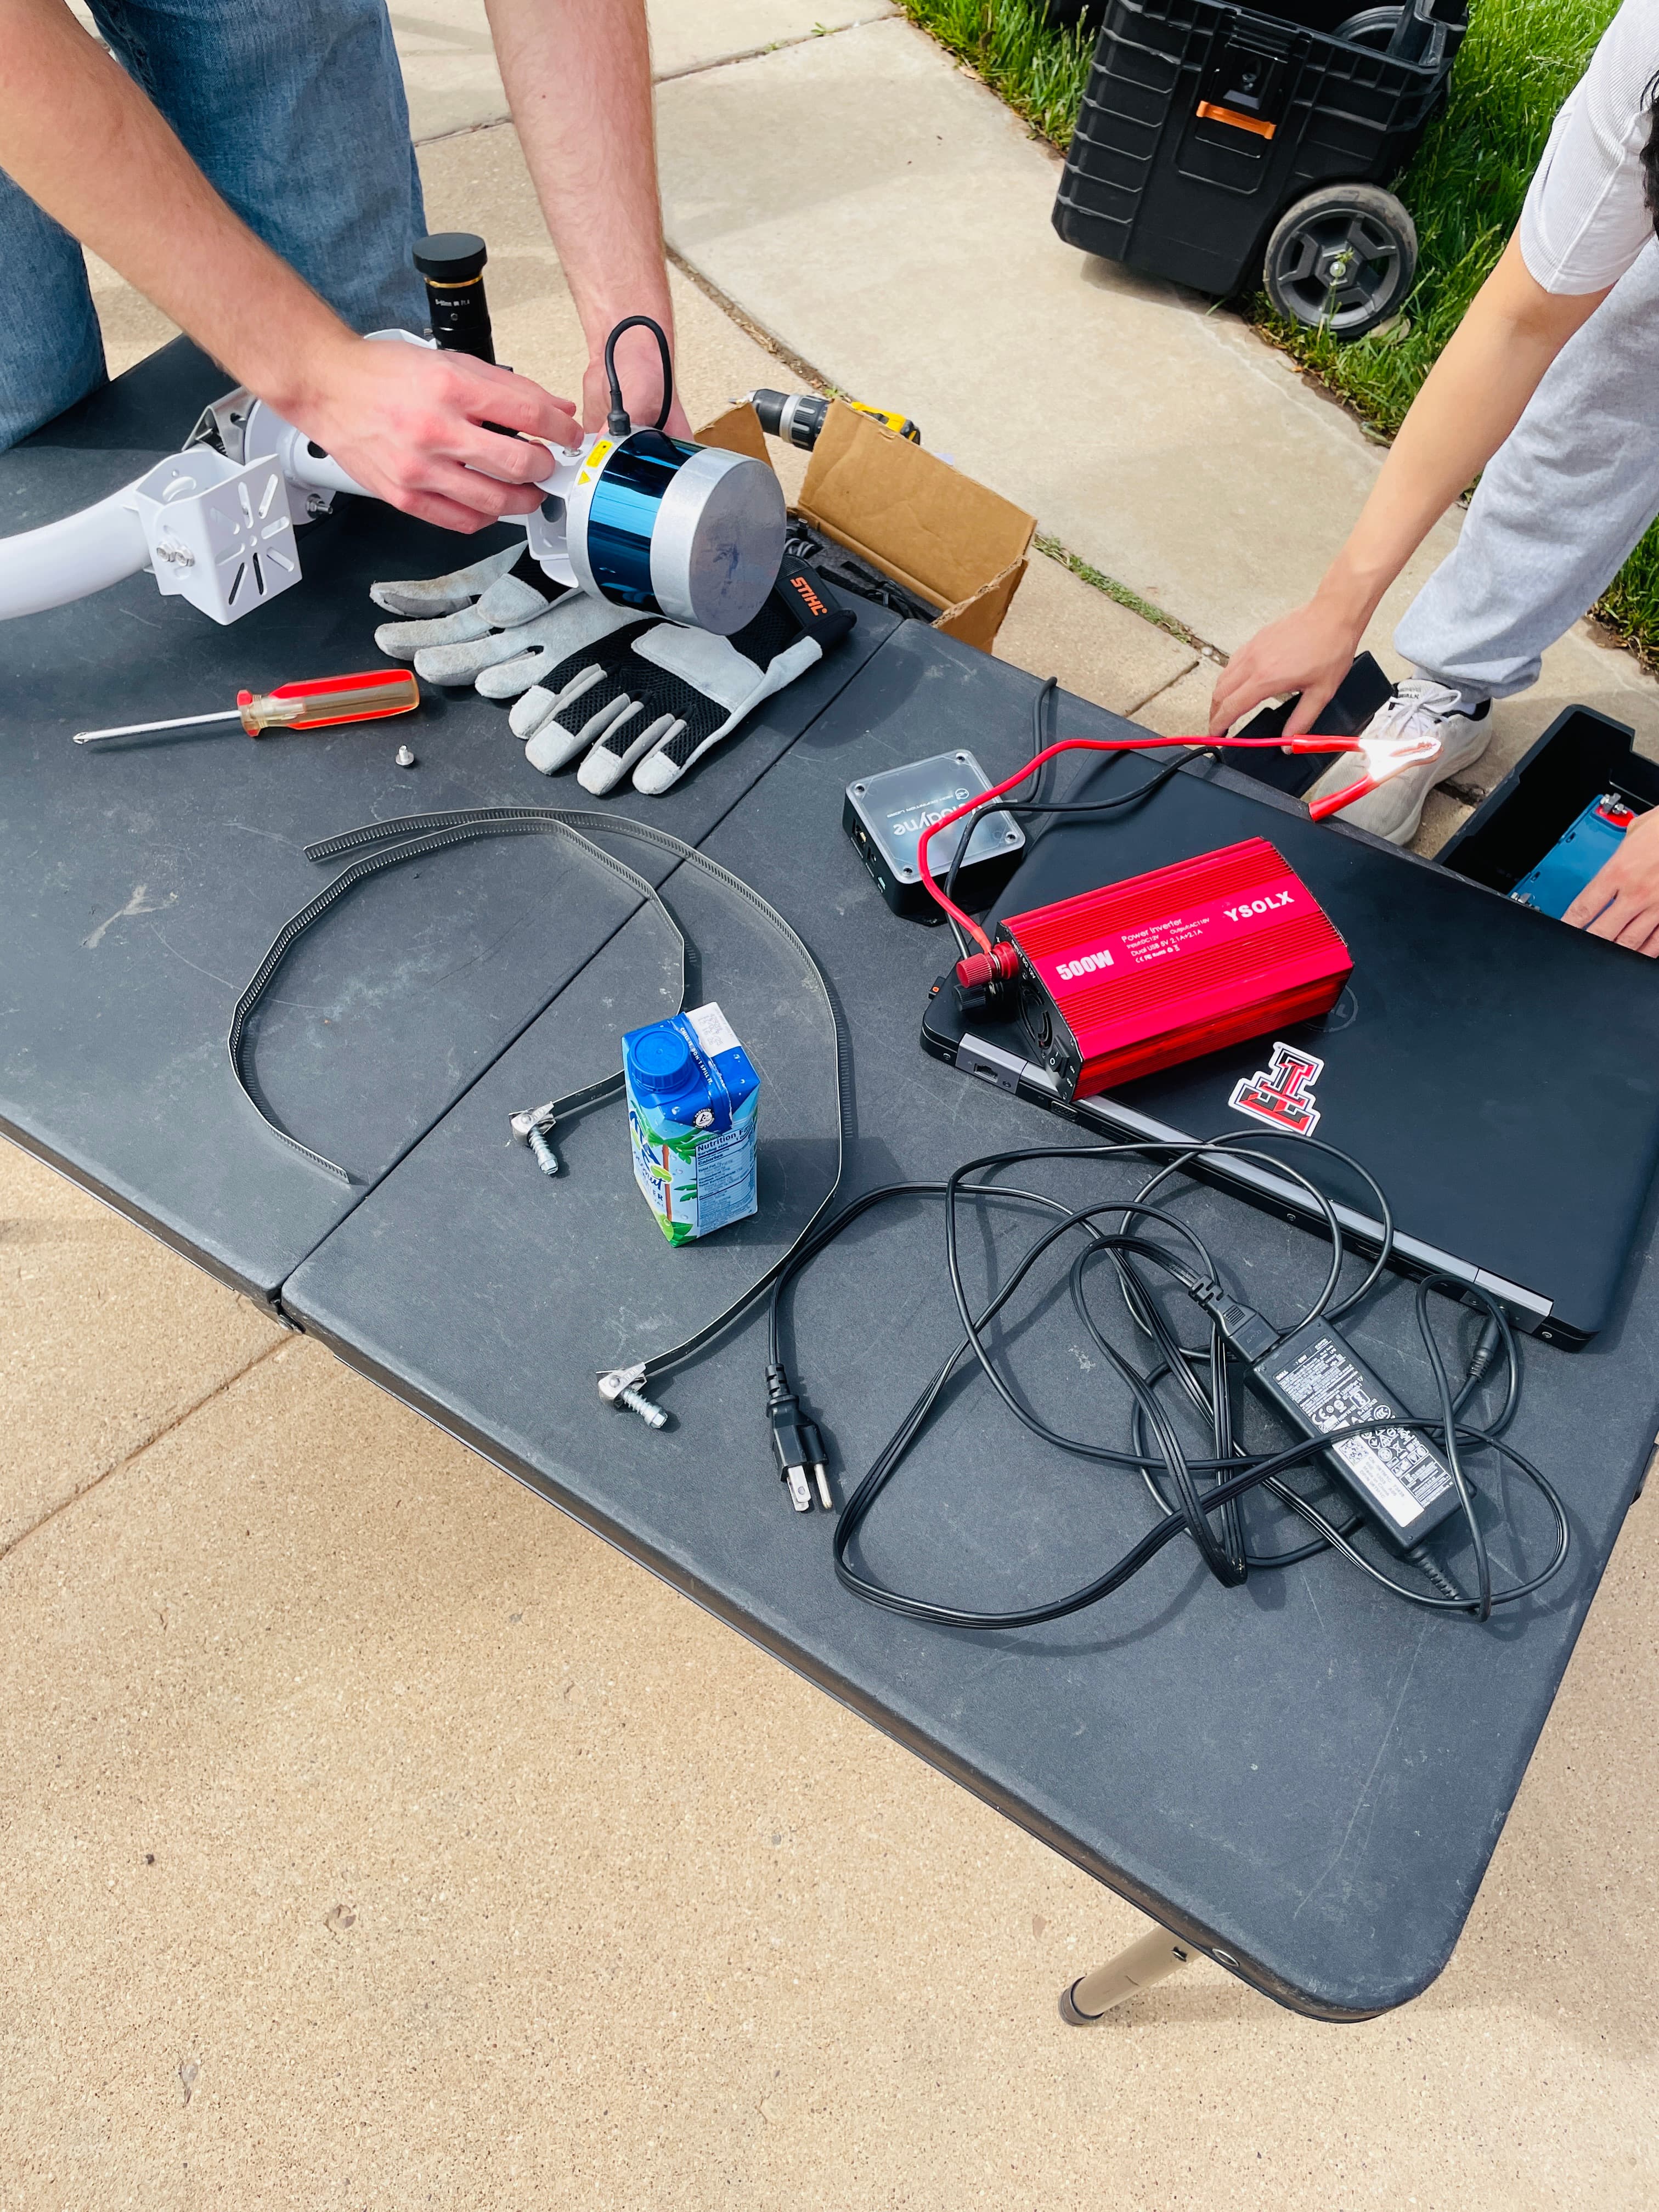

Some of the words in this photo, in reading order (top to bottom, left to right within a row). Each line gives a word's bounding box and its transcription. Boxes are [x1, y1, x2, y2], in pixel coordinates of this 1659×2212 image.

[790, 577, 825, 616] STIHL
[1223, 891, 1295, 922] YSOLX
[1121, 929, 1149, 943] Power
[1149, 918, 1182, 934] Inverter
[1131, 947, 1147, 956] Dual
[1147, 943, 1160, 951] USB
[1056, 950, 1114, 980] 500W
[680, 1027, 690, 1041] CHILL
[691, 1048, 702, 1064] DON'T
[700, 1063, 710, 1080] SPILL
[698, 1133, 736, 1152] Nutrition
[698, 1154, 723, 1165] Calories
